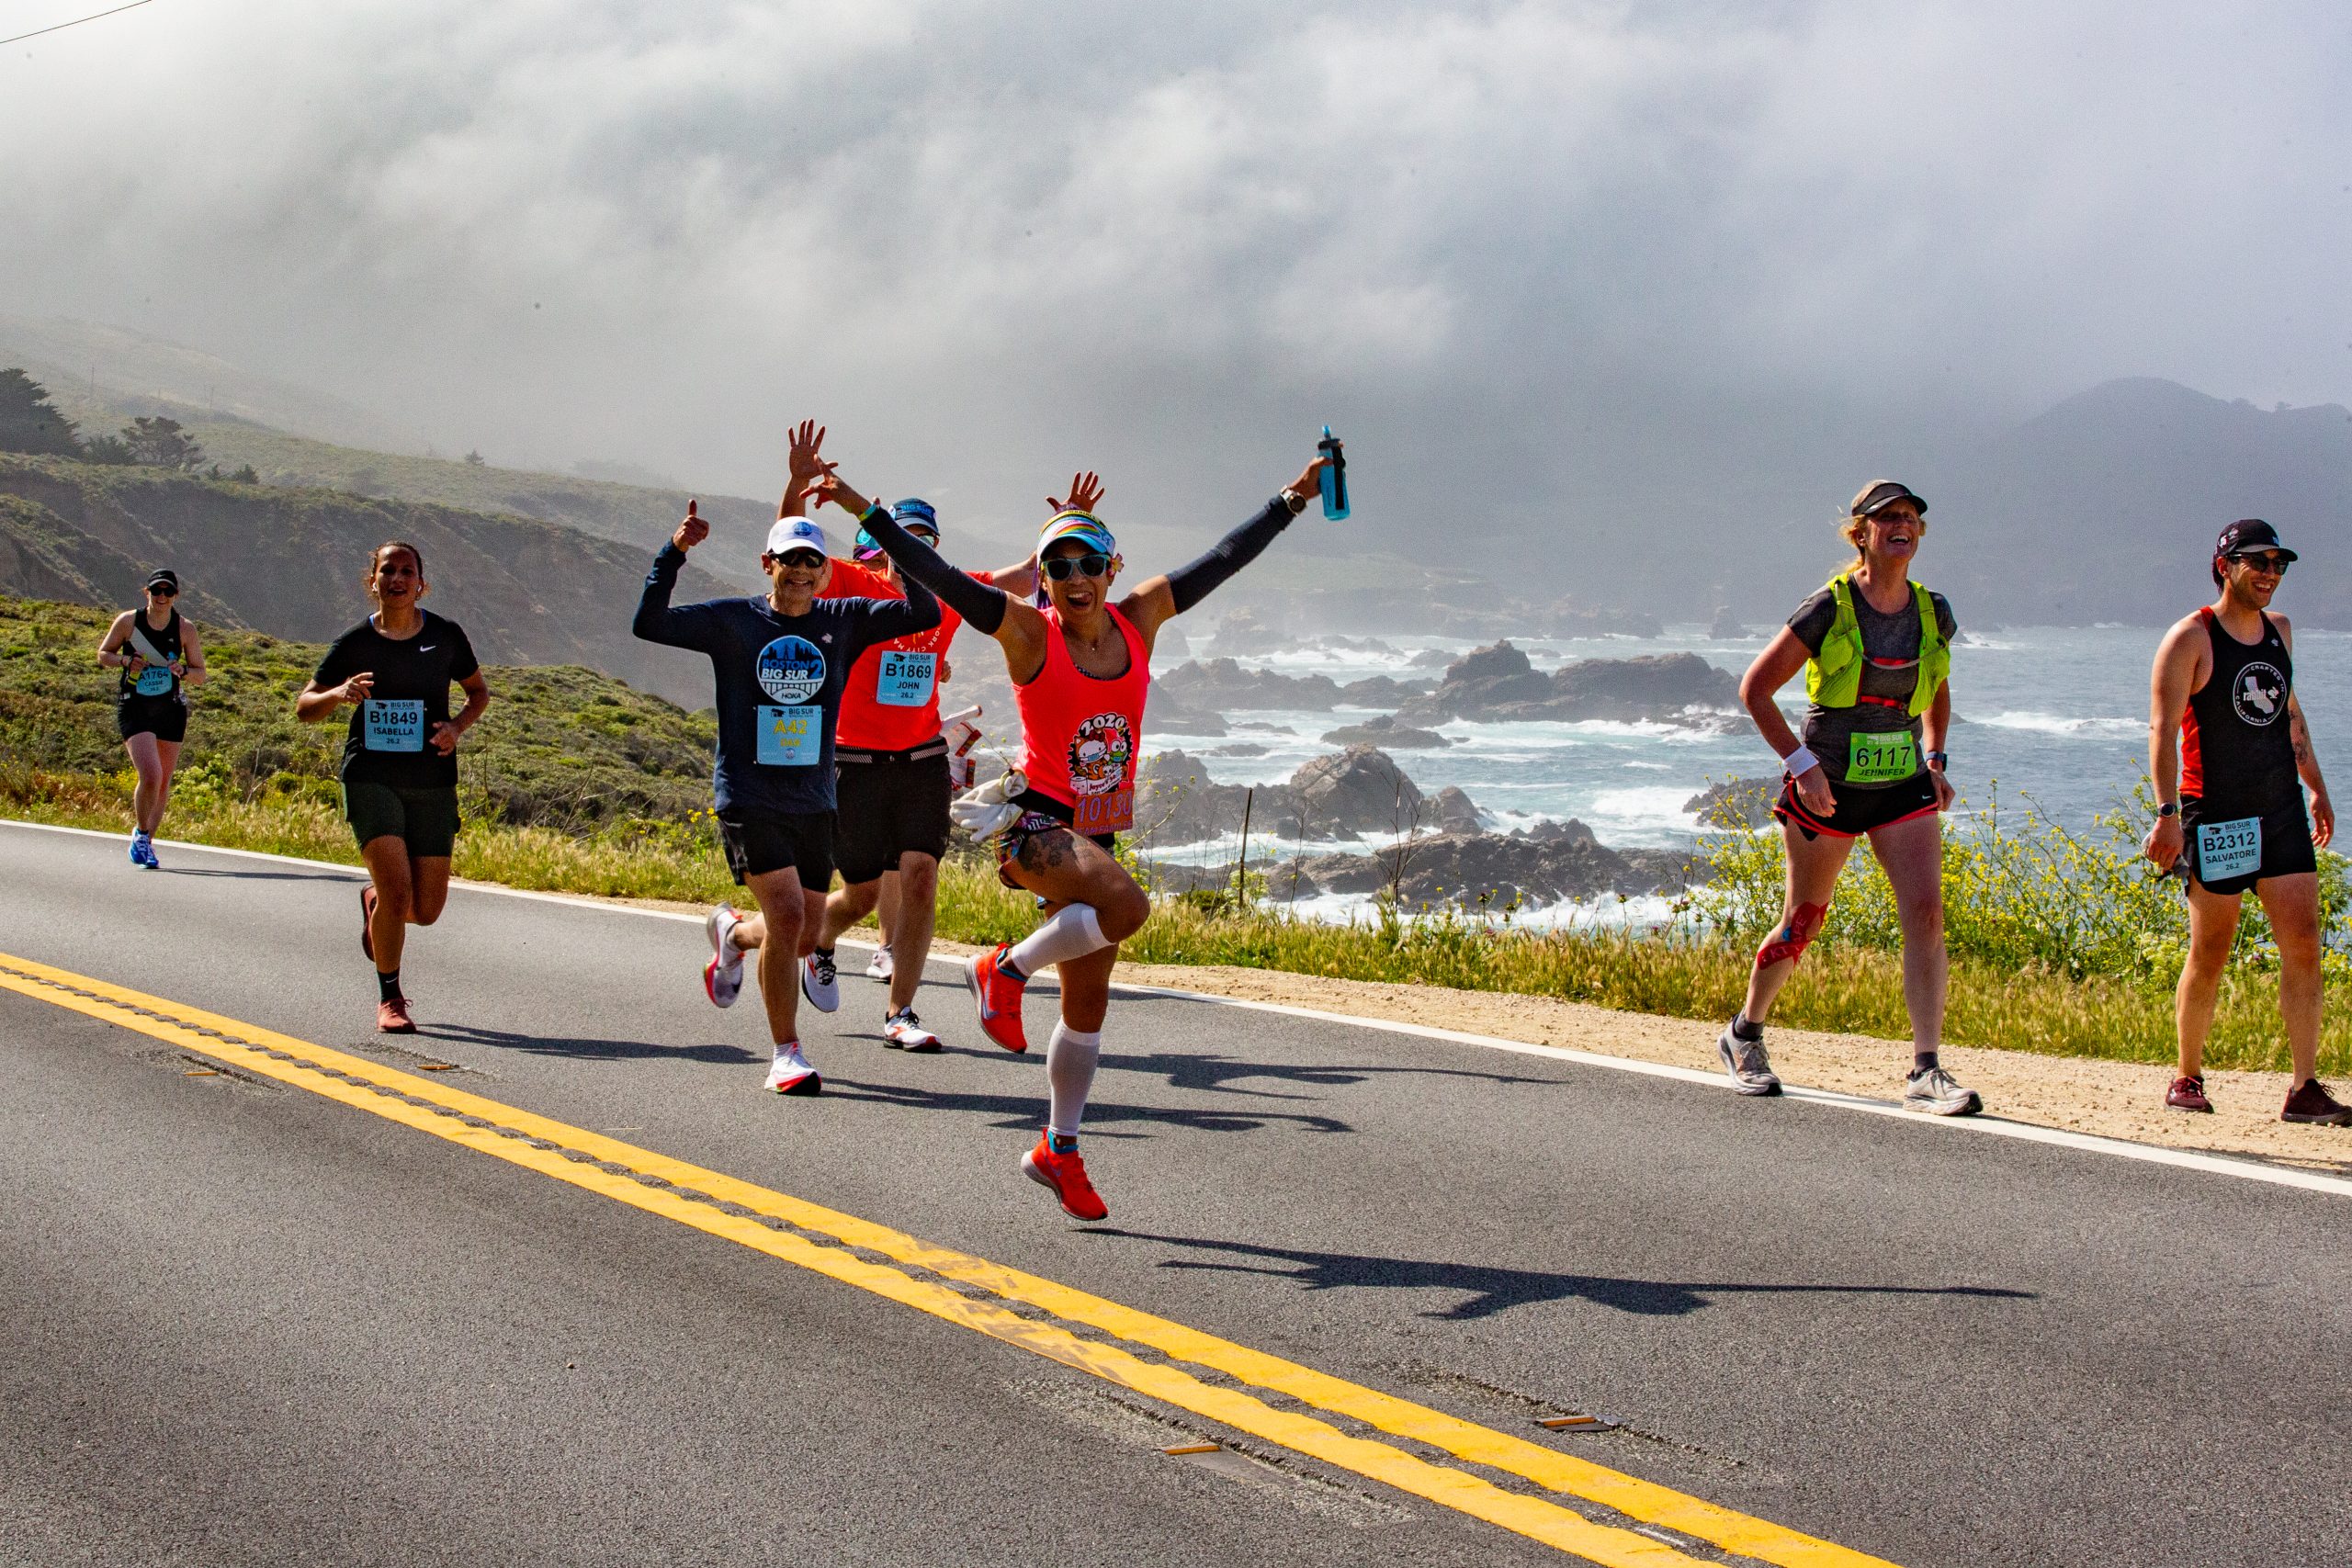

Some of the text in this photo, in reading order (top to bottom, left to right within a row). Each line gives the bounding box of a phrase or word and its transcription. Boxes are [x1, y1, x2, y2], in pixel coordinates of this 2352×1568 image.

[763, 659, 808, 670] BOSTON
[809, 660, 822, 679] 2
[886, 663, 931, 678] B1869
[762, 668, 808, 680] BIG SUR
[2251, 665, 2280, 681] CRAFTED
[897, 681, 920, 689] JOHN
[2235, 695, 2267, 723] CALIFORNIA
[370, 711, 417, 725] B1849
[1080, 713, 1125, 735] 2020
[373, 727, 414, 736] ISABELLA
[774, 719, 807, 734] A42
[1856, 746, 1911, 767] 6117
[1859, 768, 1905, 776] JENNIFER
[1078, 791, 1132, 824] 10130
[2204, 832, 2256, 852] B2312
[2205, 849, 2257, 863] SALVATORE
